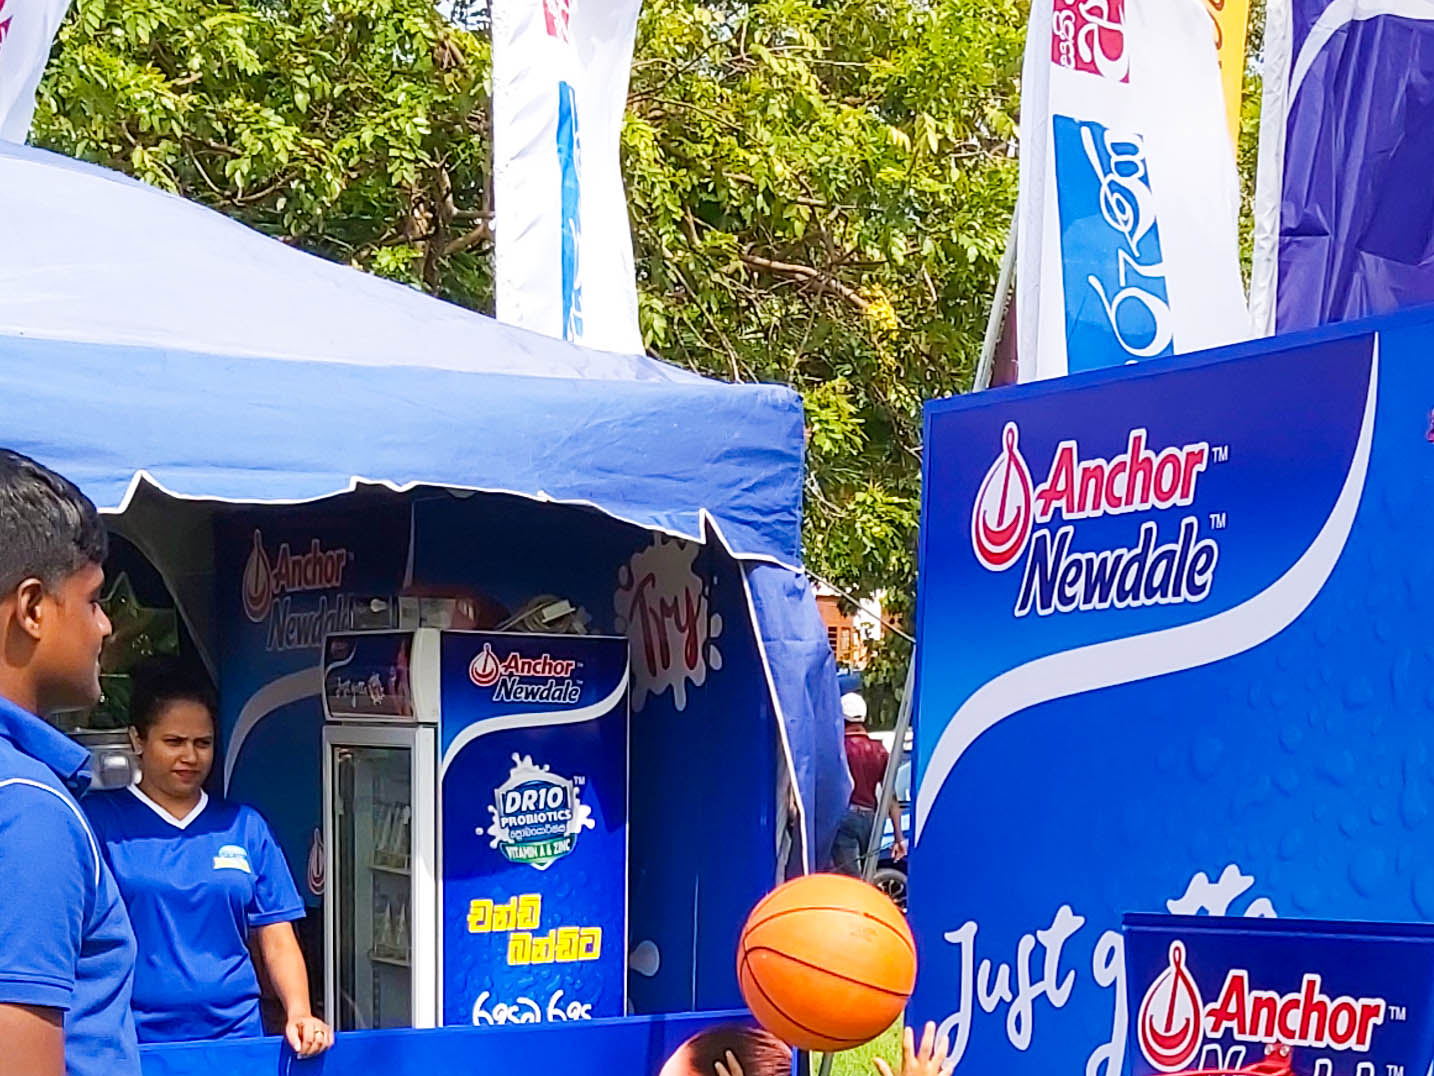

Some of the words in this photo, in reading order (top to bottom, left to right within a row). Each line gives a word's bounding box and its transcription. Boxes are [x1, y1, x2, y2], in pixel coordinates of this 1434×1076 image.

[1035, 429, 1207, 521] Anchor
[272, 538, 346, 592] Anchor
[1015, 515, 1217, 617] Newdale
[629, 572, 702, 678] Try
[493, 676, 580, 703] Newdale
[500, 652, 575, 677] Anchor
[501, 809, 571, 827] PROBIOTICS
[505, 786, 563, 813] DR10
[936, 905, 1085, 1072] Just
[1203, 969, 1385, 1051] Anchor
